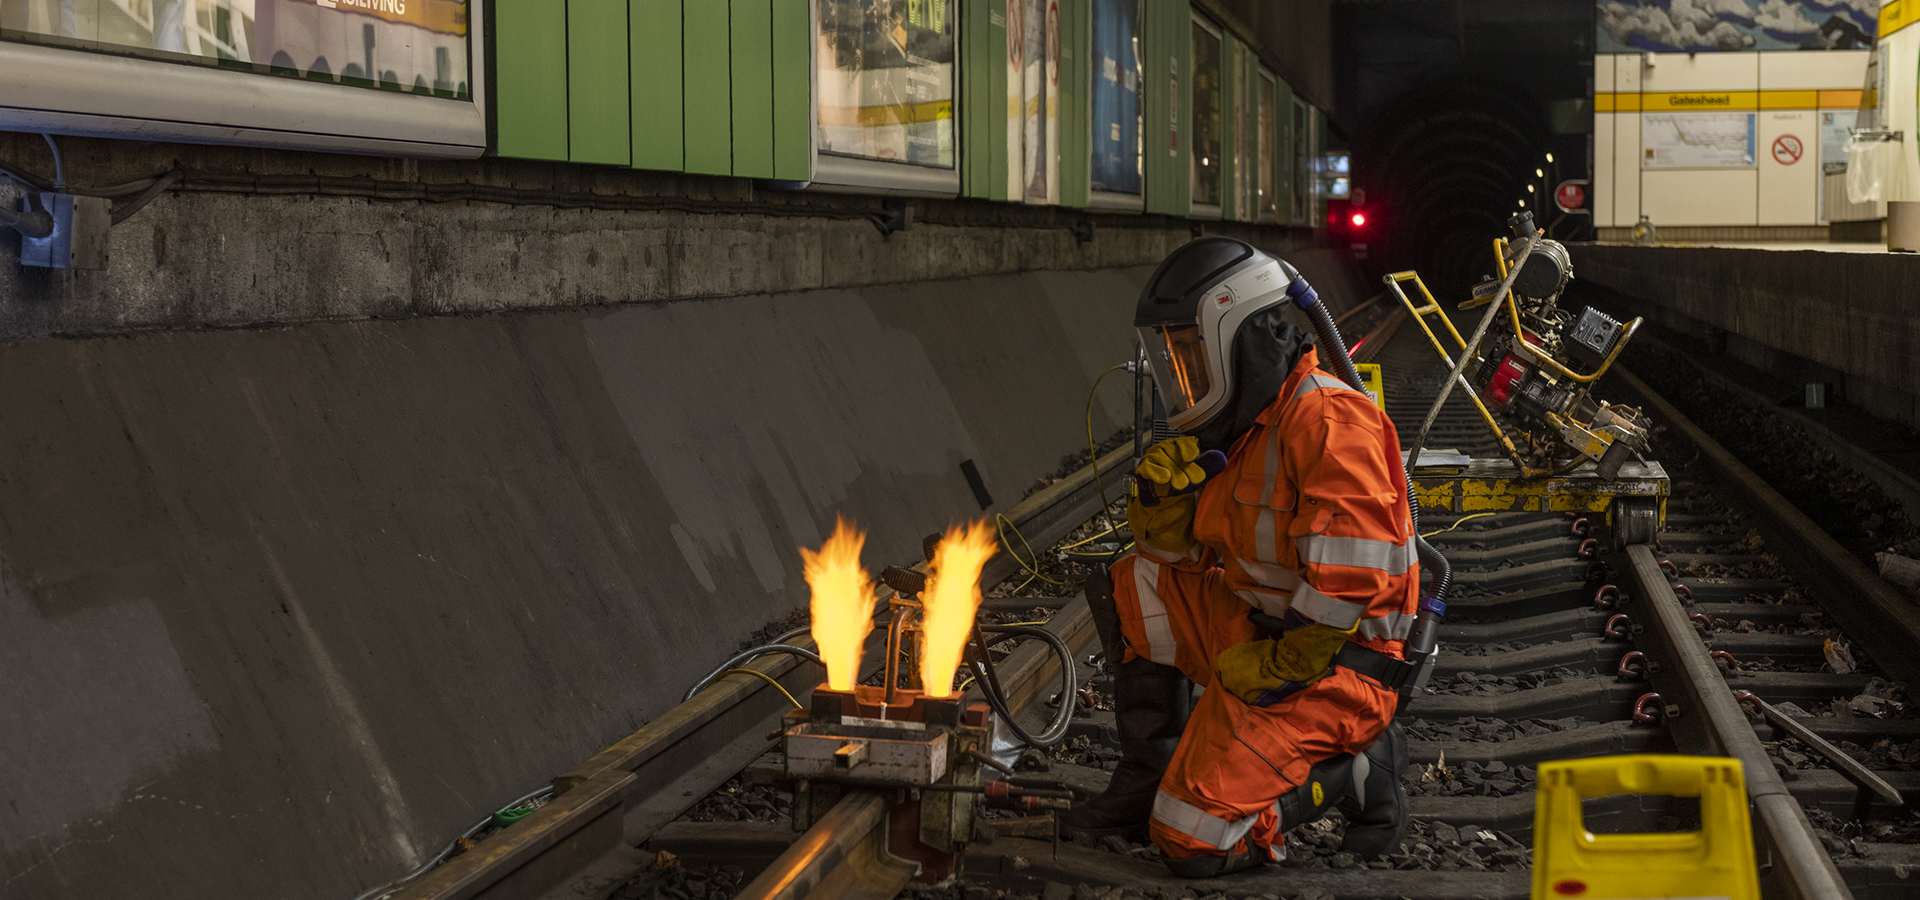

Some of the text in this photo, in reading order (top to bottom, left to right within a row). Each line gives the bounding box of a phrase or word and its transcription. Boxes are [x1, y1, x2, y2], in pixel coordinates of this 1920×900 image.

[317, 0, 405, 15] SILIVING
[1669, 94, 1730, 106] Gateshead
[1218, 295, 1230, 304] 3M
